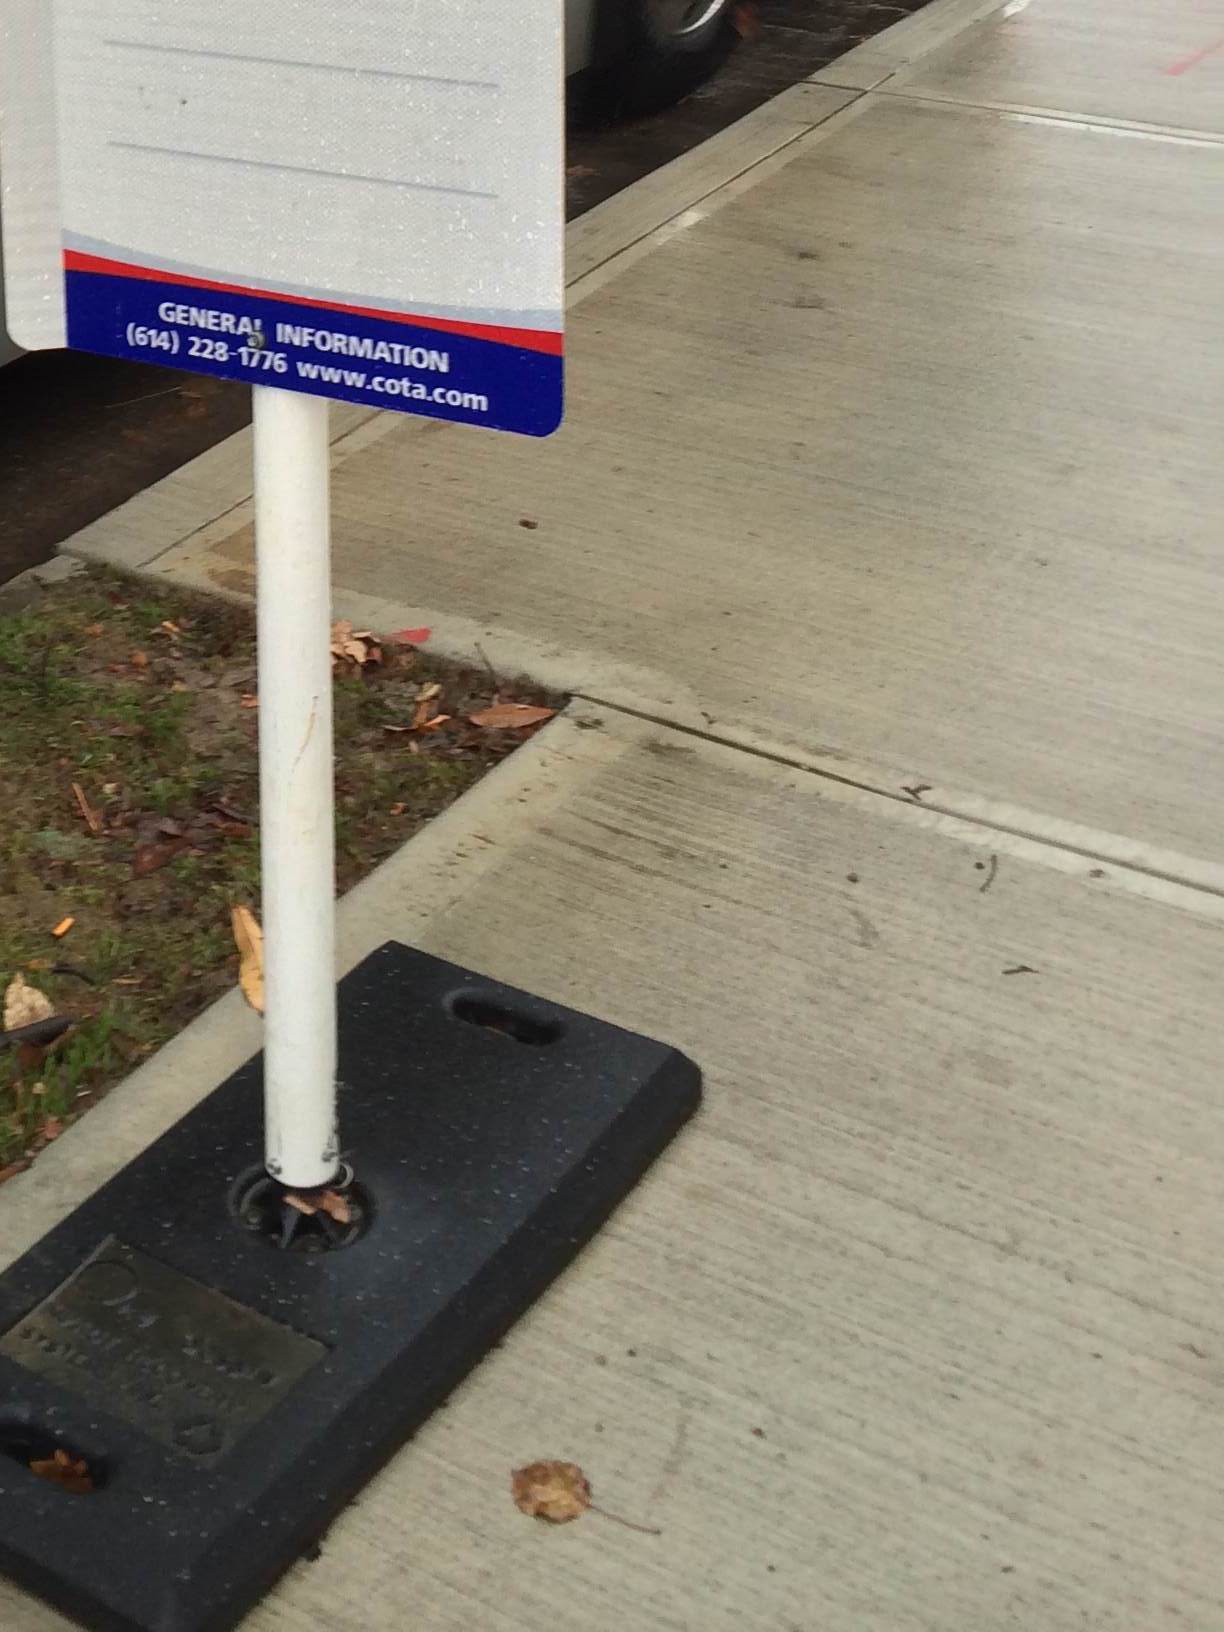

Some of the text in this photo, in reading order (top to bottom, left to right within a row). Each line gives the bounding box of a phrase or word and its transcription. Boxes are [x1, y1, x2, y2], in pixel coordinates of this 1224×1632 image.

[126, 322, 490, 412] (614) 228-1776 www.cota.com
[276, 322, 450, 374] INFORMATION
